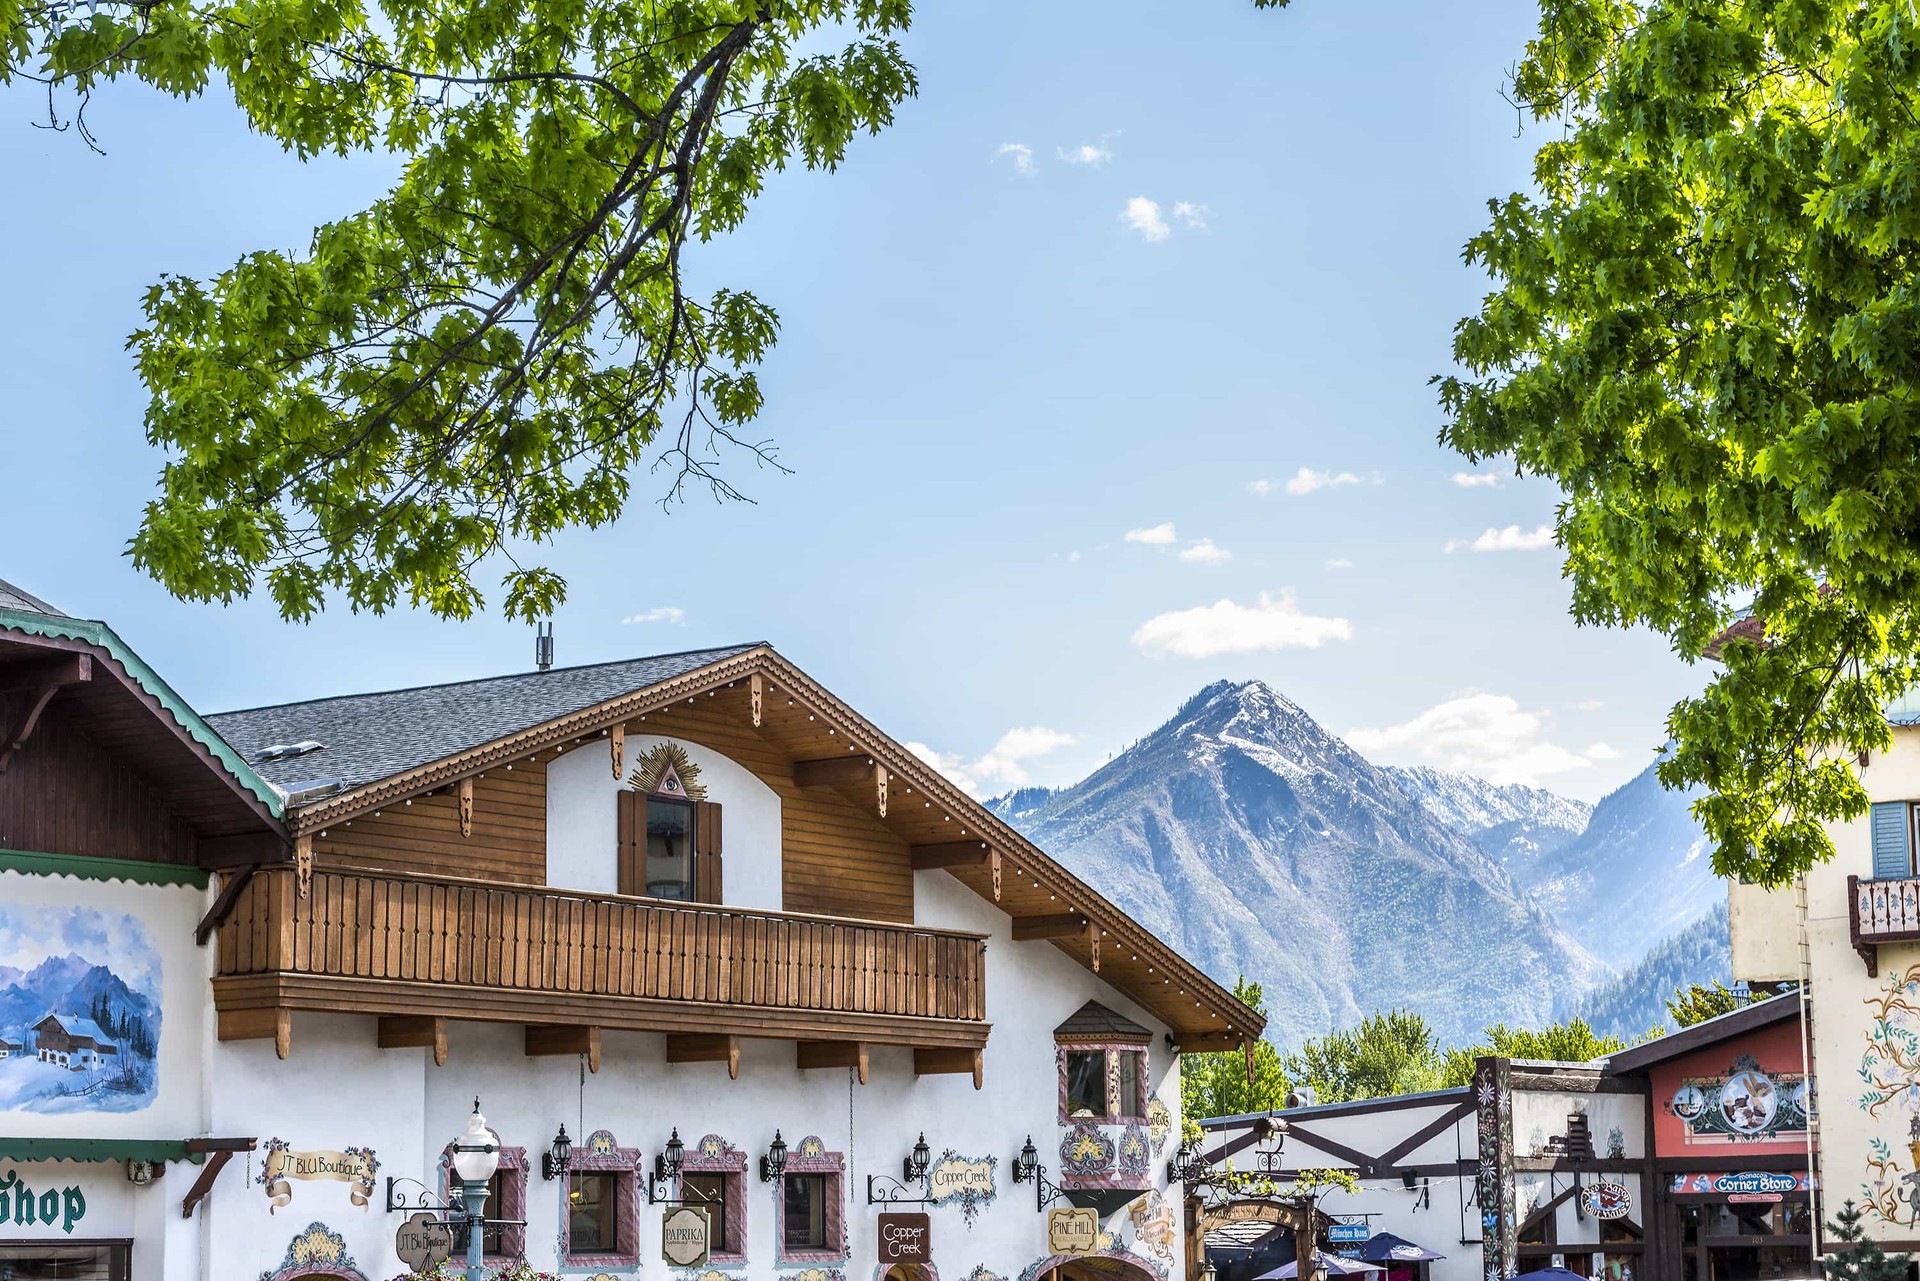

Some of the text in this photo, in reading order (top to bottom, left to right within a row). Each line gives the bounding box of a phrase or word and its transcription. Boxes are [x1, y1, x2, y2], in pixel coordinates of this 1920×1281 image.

[277, 1155, 363, 1181] JT BLU Boutique
[935, 1168, 988, 1187] Copper Creek
[1718, 1177, 1793, 1191] Corner Store
[1601, 1183, 1630, 1202] Baron
[666, 1228, 704, 1241] PAPRIKA
[1053, 1221, 1091, 1235] PINE HILL
[400, 1234, 410, 1251] JT
[883, 1223, 925, 1257] Copper Creek
